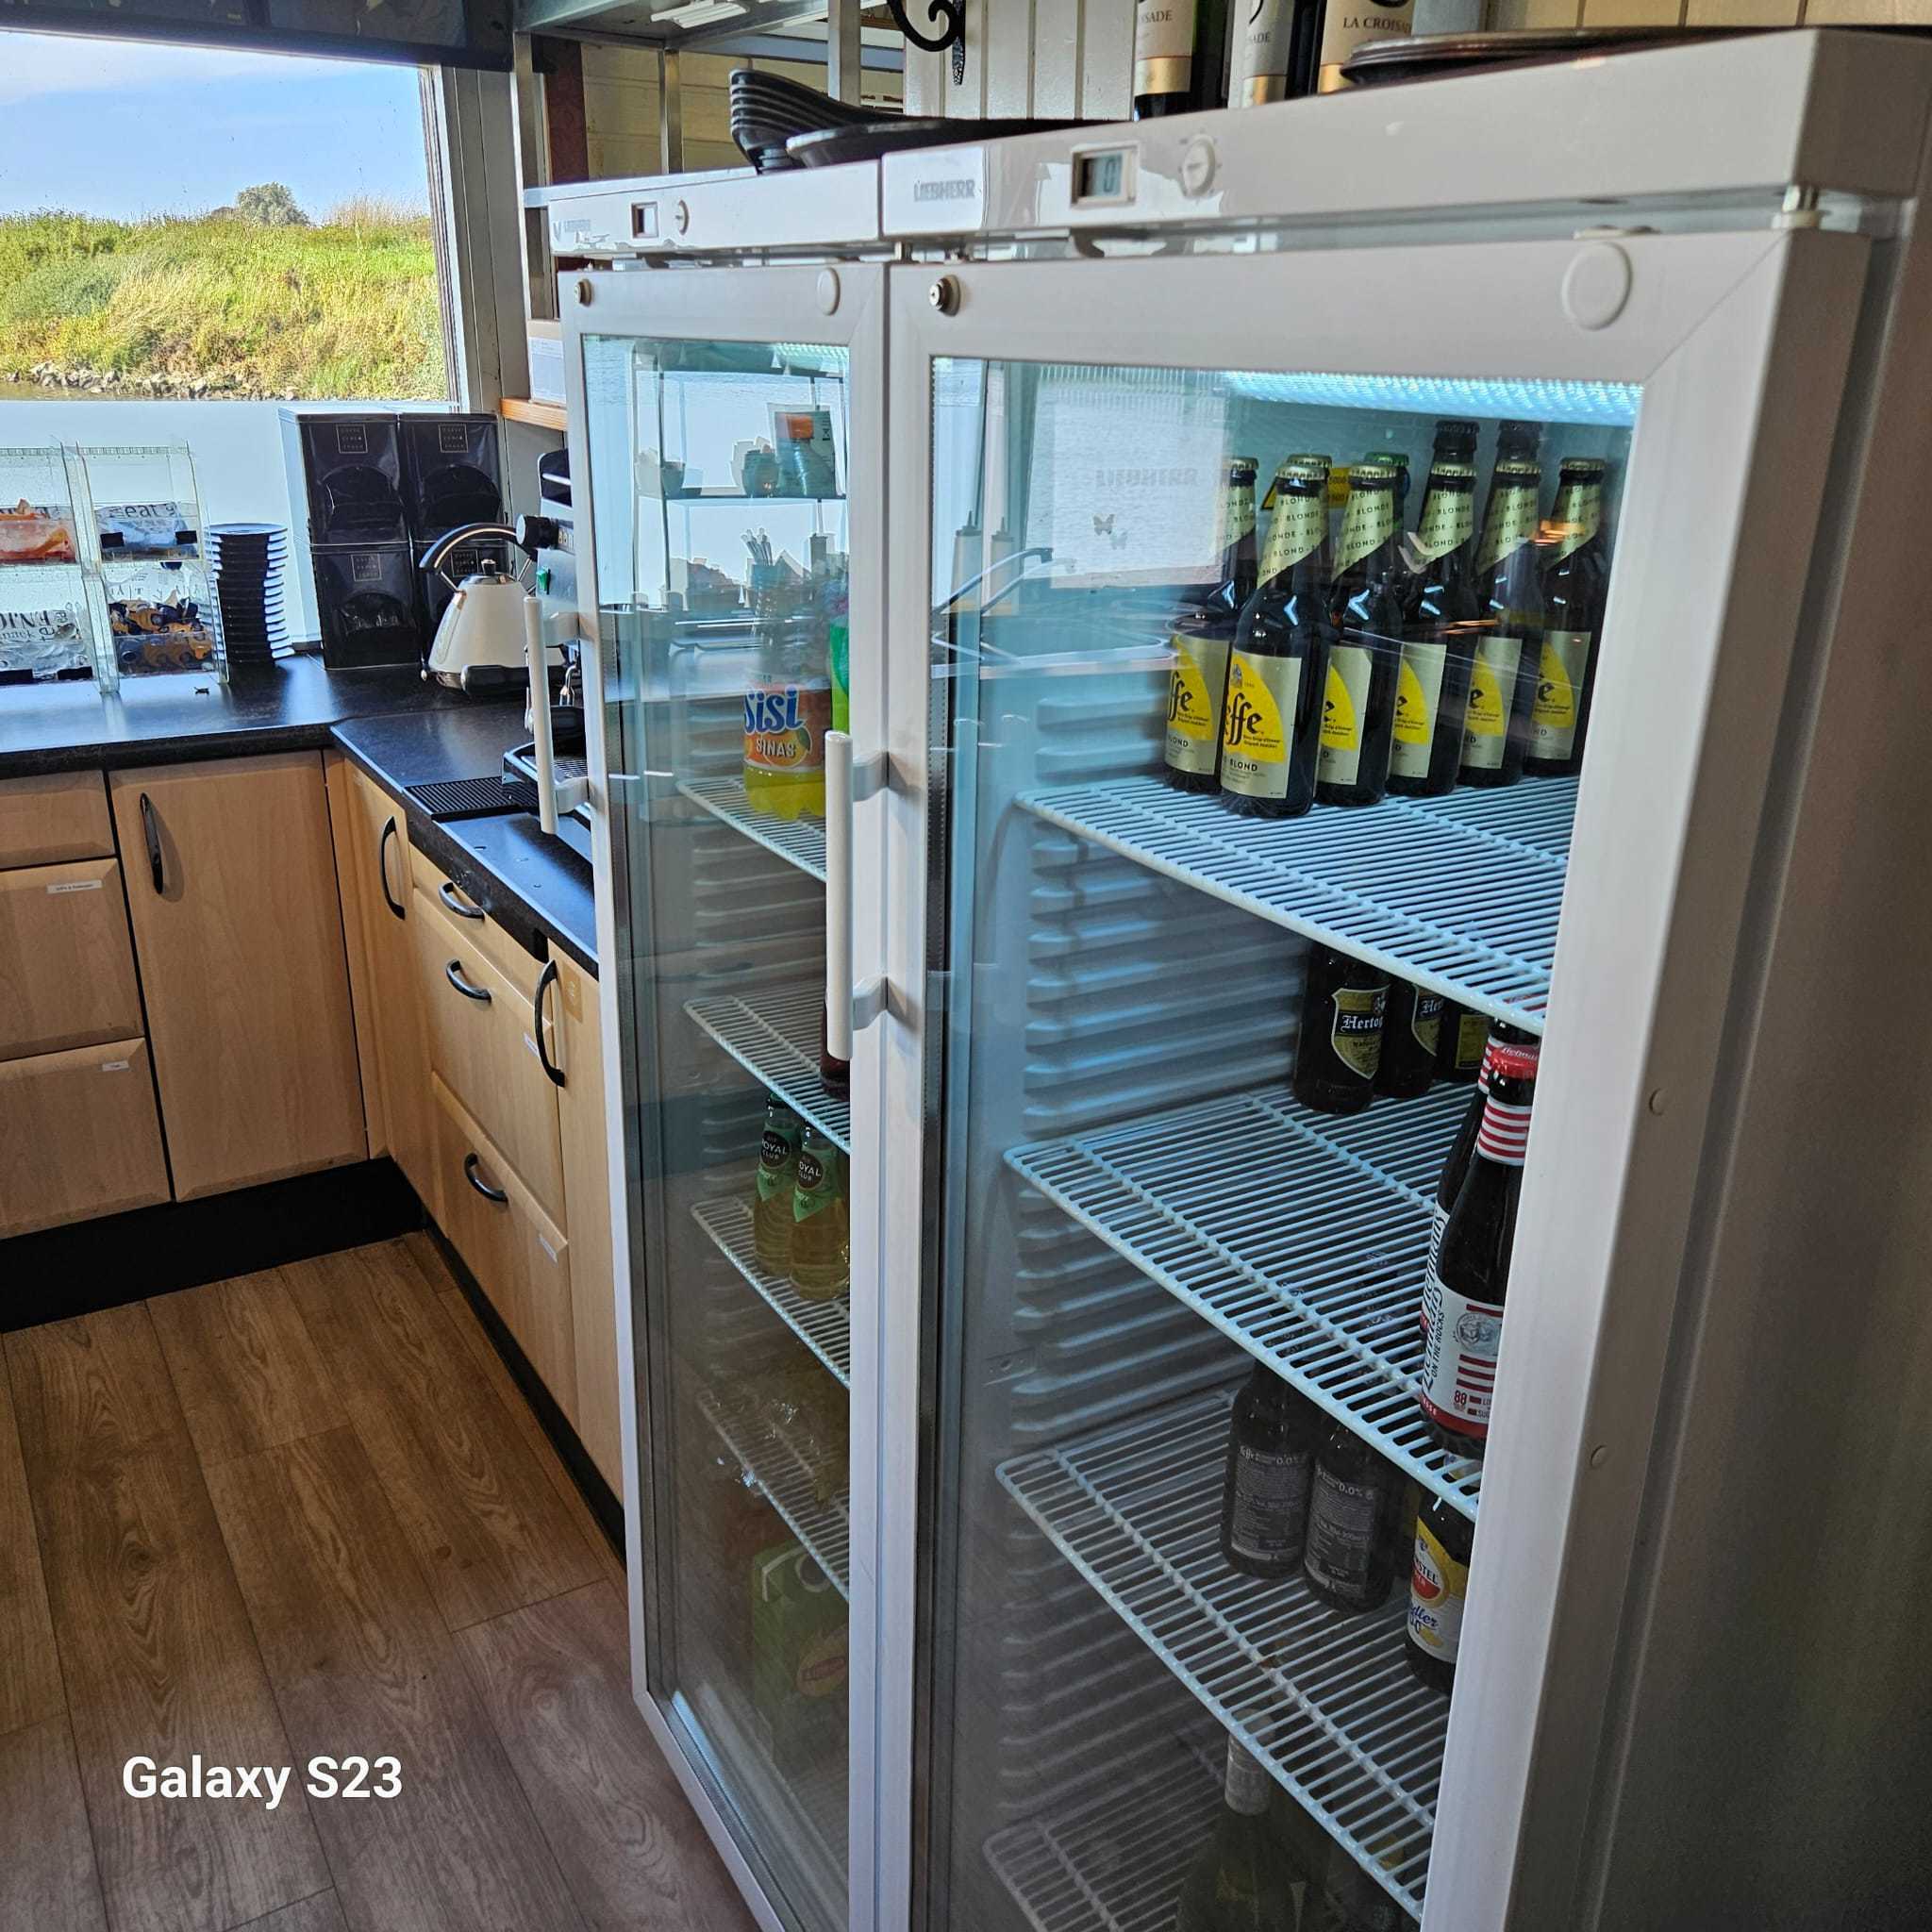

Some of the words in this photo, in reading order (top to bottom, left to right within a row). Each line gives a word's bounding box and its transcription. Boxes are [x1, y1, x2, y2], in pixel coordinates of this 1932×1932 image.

[1343, 17, 1358, 28] LA
[913, 179, 975, 202] LIEBHERR
[756, 738, 795, 758] SINAS
[1229, 758, 1258, 773] BLOND
[799, 1161, 822, 1177] OYAL
[1435, 1309, 1445, 1344] ROCKS
[1432, 1344, 1441, 1363] THE
[1430, 1365, 1439, 1379] ON
[1454, 1390, 1467, 1406] 88
